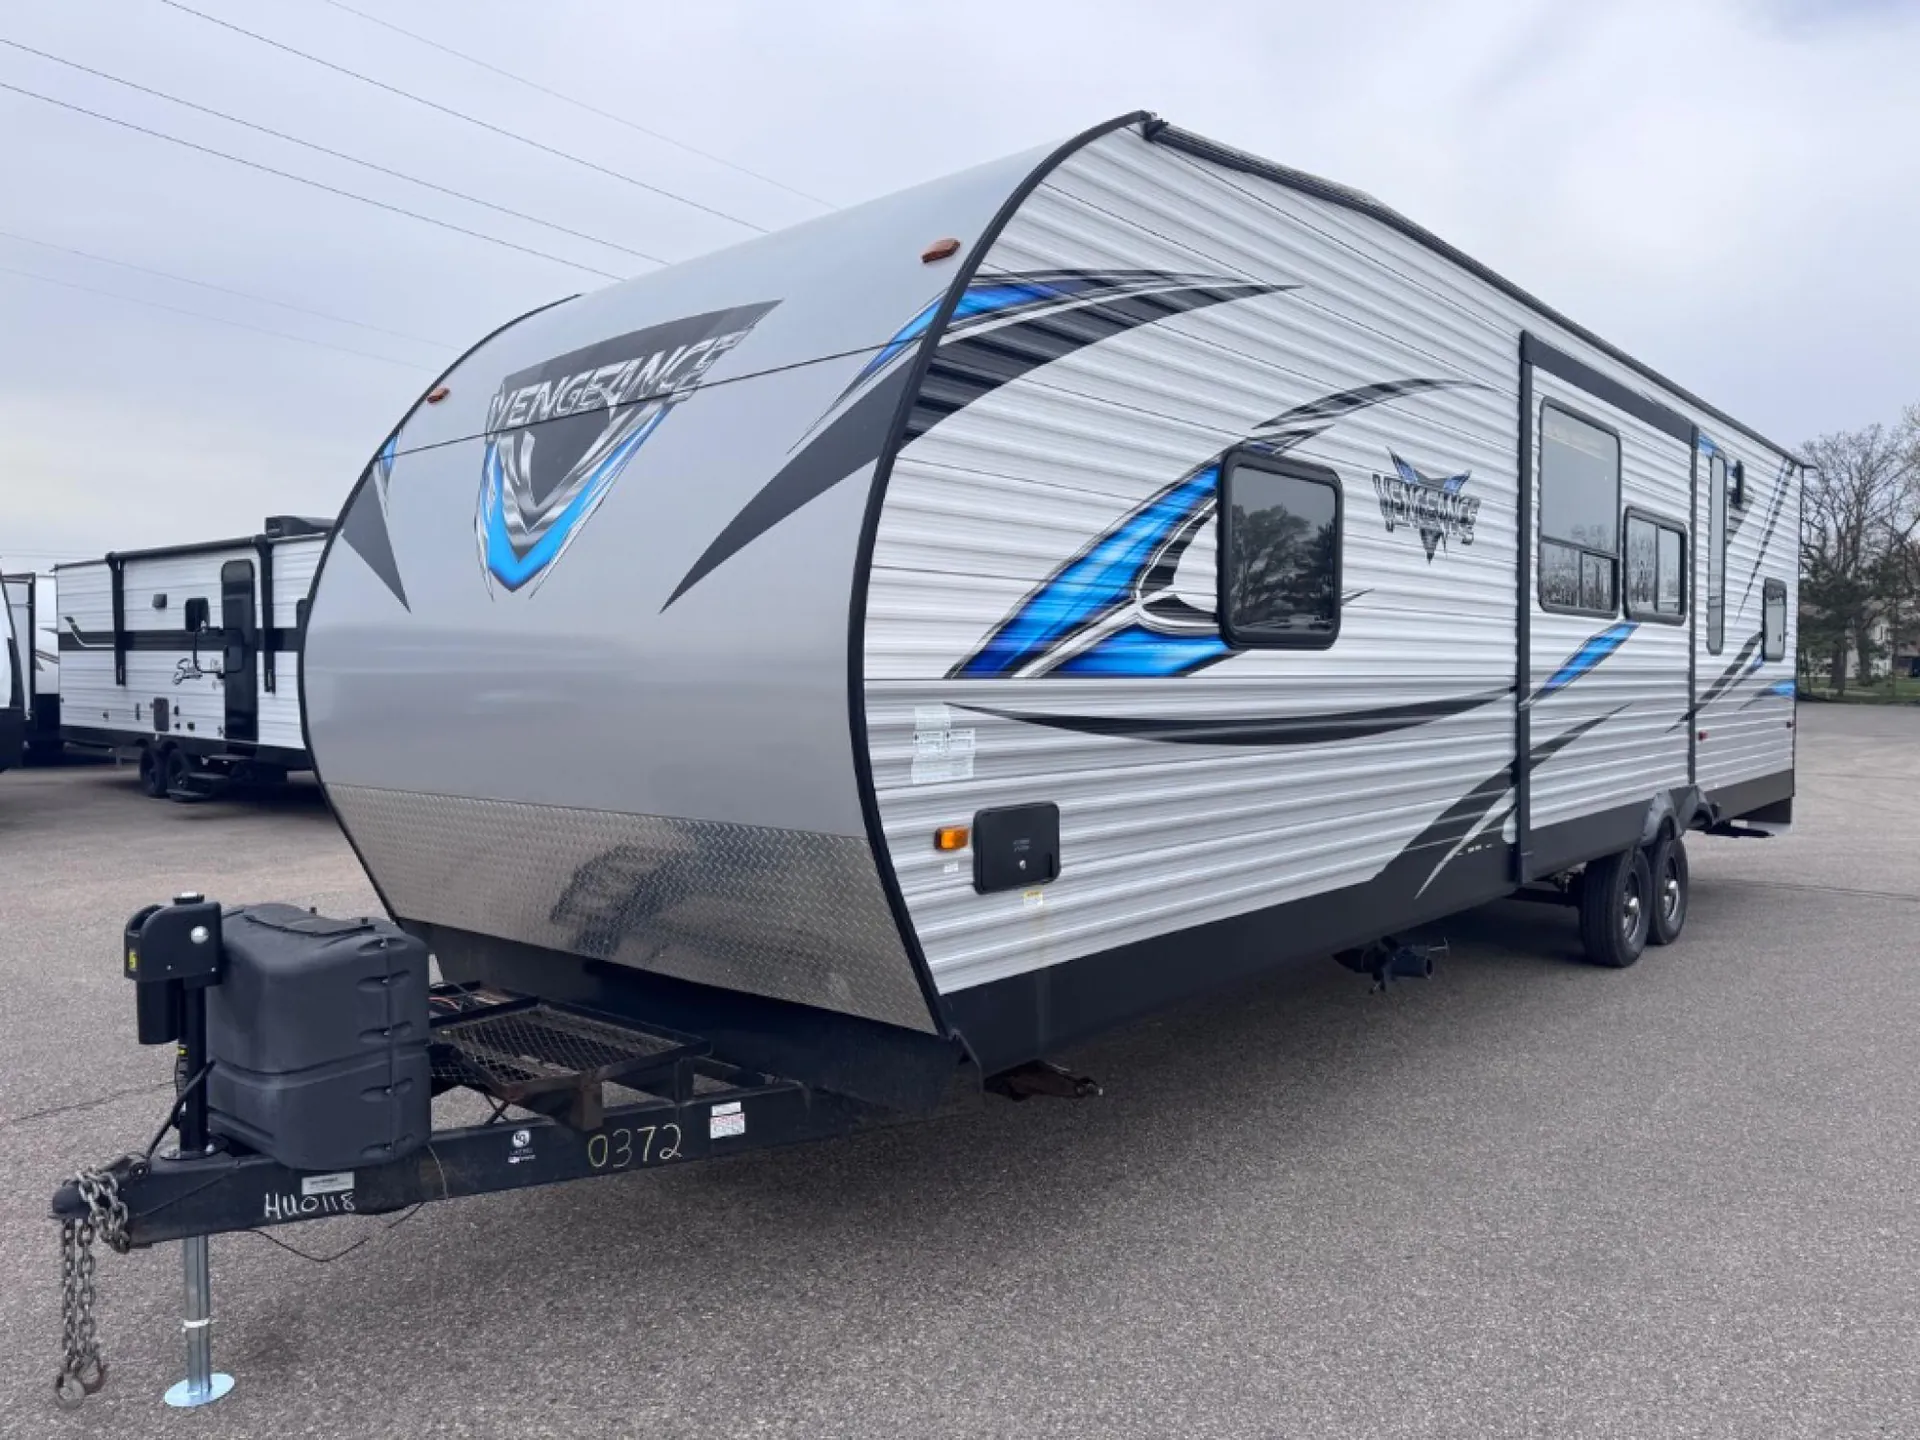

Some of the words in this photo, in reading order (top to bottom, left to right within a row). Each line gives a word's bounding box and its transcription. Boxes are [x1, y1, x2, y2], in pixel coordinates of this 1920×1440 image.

[487, 331, 754, 441] VENGEANCE
[1372, 474, 1480, 544] VENGEANCE
[588, 1123, 682, 1168] 0372
